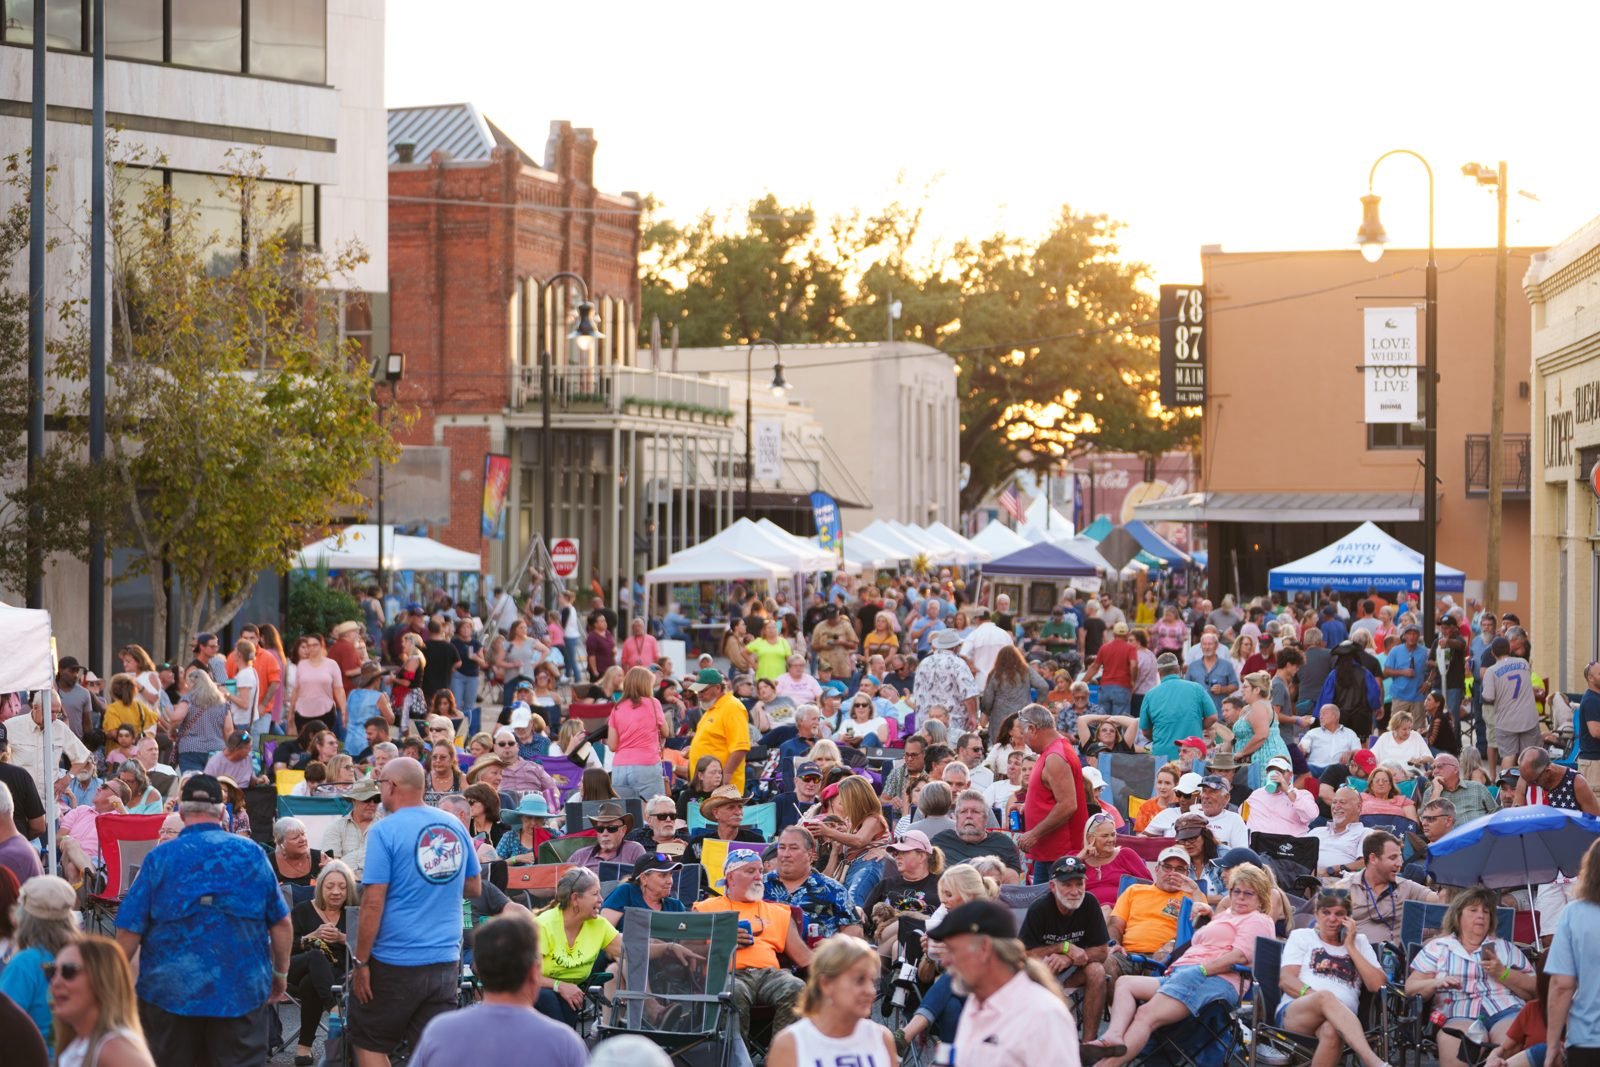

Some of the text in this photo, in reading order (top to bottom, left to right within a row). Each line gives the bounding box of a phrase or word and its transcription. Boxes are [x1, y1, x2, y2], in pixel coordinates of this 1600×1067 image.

[1175, 289, 1203, 323] 78
[1175, 325, 1203, 360] 87
[1371, 337, 1411, 350] LOVE
[1371, 351, 1411, 361] WHERE
[1175, 368, 1204, 385] MAIN
[1373, 365, 1410, 379] YOU
[1374, 380, 1409, 392] LIVE
[1336, 543, 1381, 552] BAYOU
[1330, 554, 1376, 565] ARTS
[1283, 576, 1408, 586] BAYOU REGIONAL ARTS COUNCIL
[1507, 674, 1522, 701] 7
